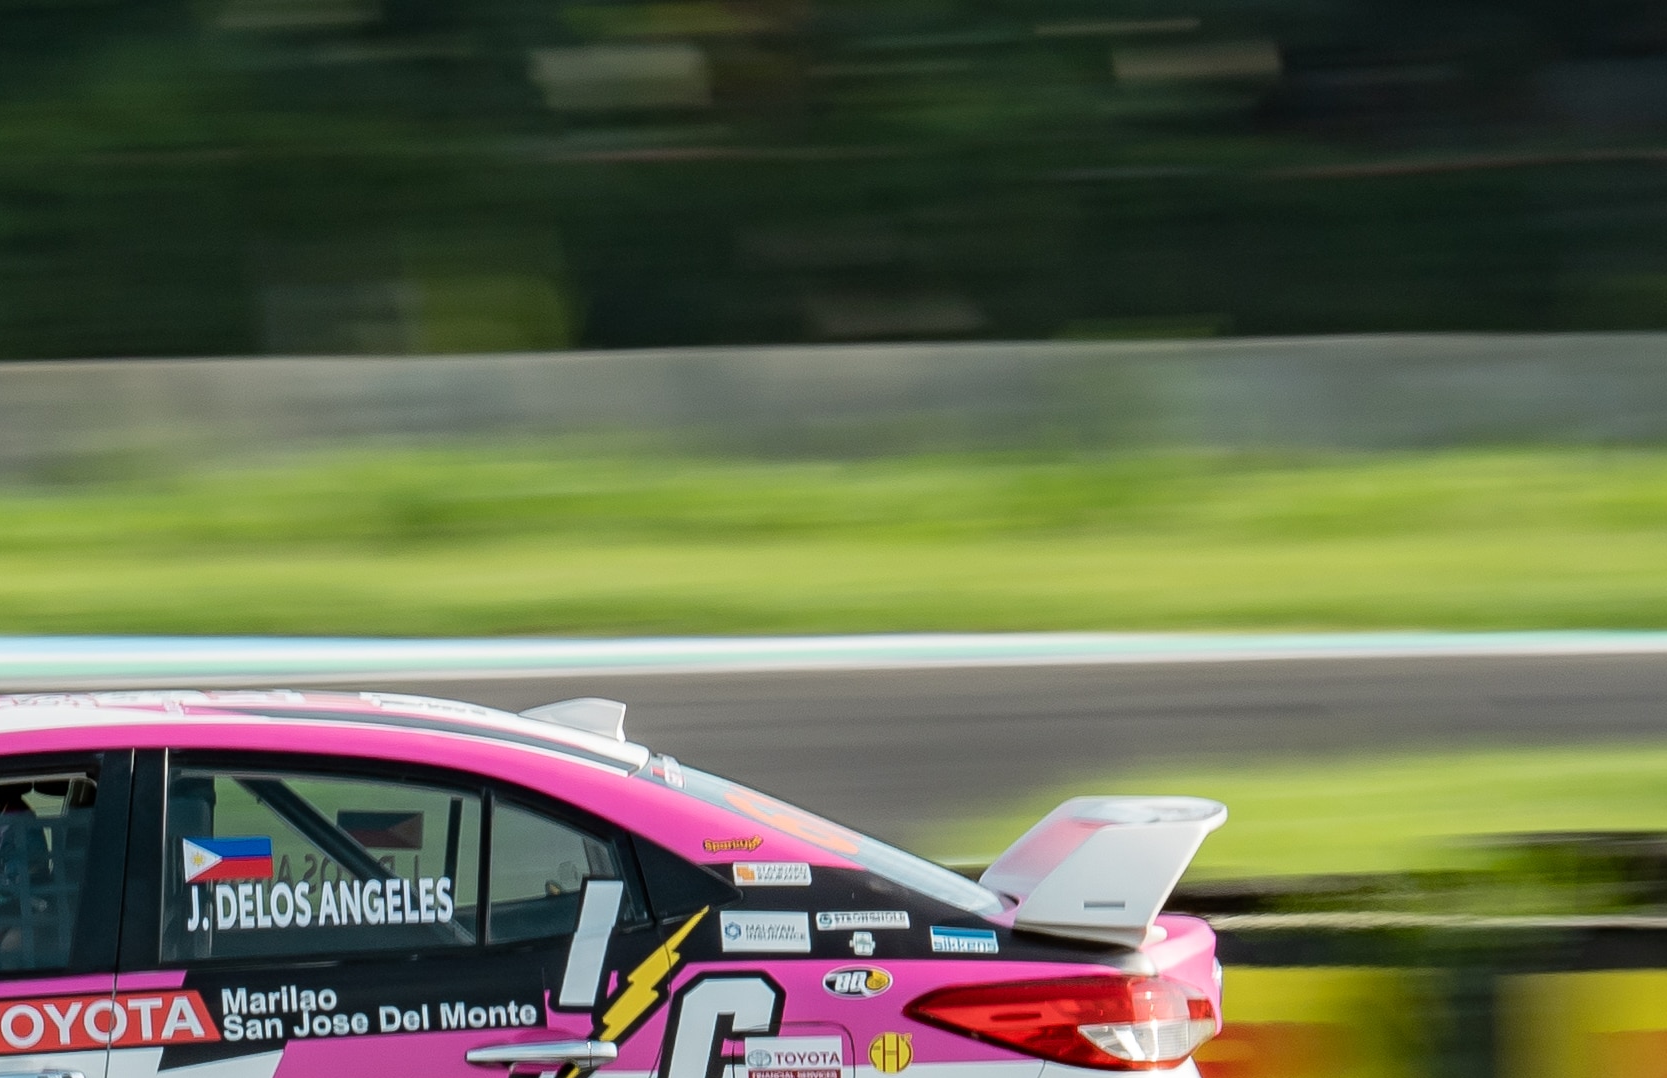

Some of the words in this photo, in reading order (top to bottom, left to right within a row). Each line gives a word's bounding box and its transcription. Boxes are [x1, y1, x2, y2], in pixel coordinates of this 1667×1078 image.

[187, 884, 209, 932] J.
[216, 880, 312, 931] DELOS
[319, 876, 453, 926] ANGELES
[745, 923, 796, 933] MALAYAN
[933, 936, 997, 953] sikkens
[221, 987, 338, 1014] Marilao
[222, 1013, 283, 1041] San
[293, 1010, 368, 1038] Jose
[379, 1004, 429, 1033] Del
[440, 998, 537, 1030] Monte
[775, 1050, 841, 1066] TOYOTA
